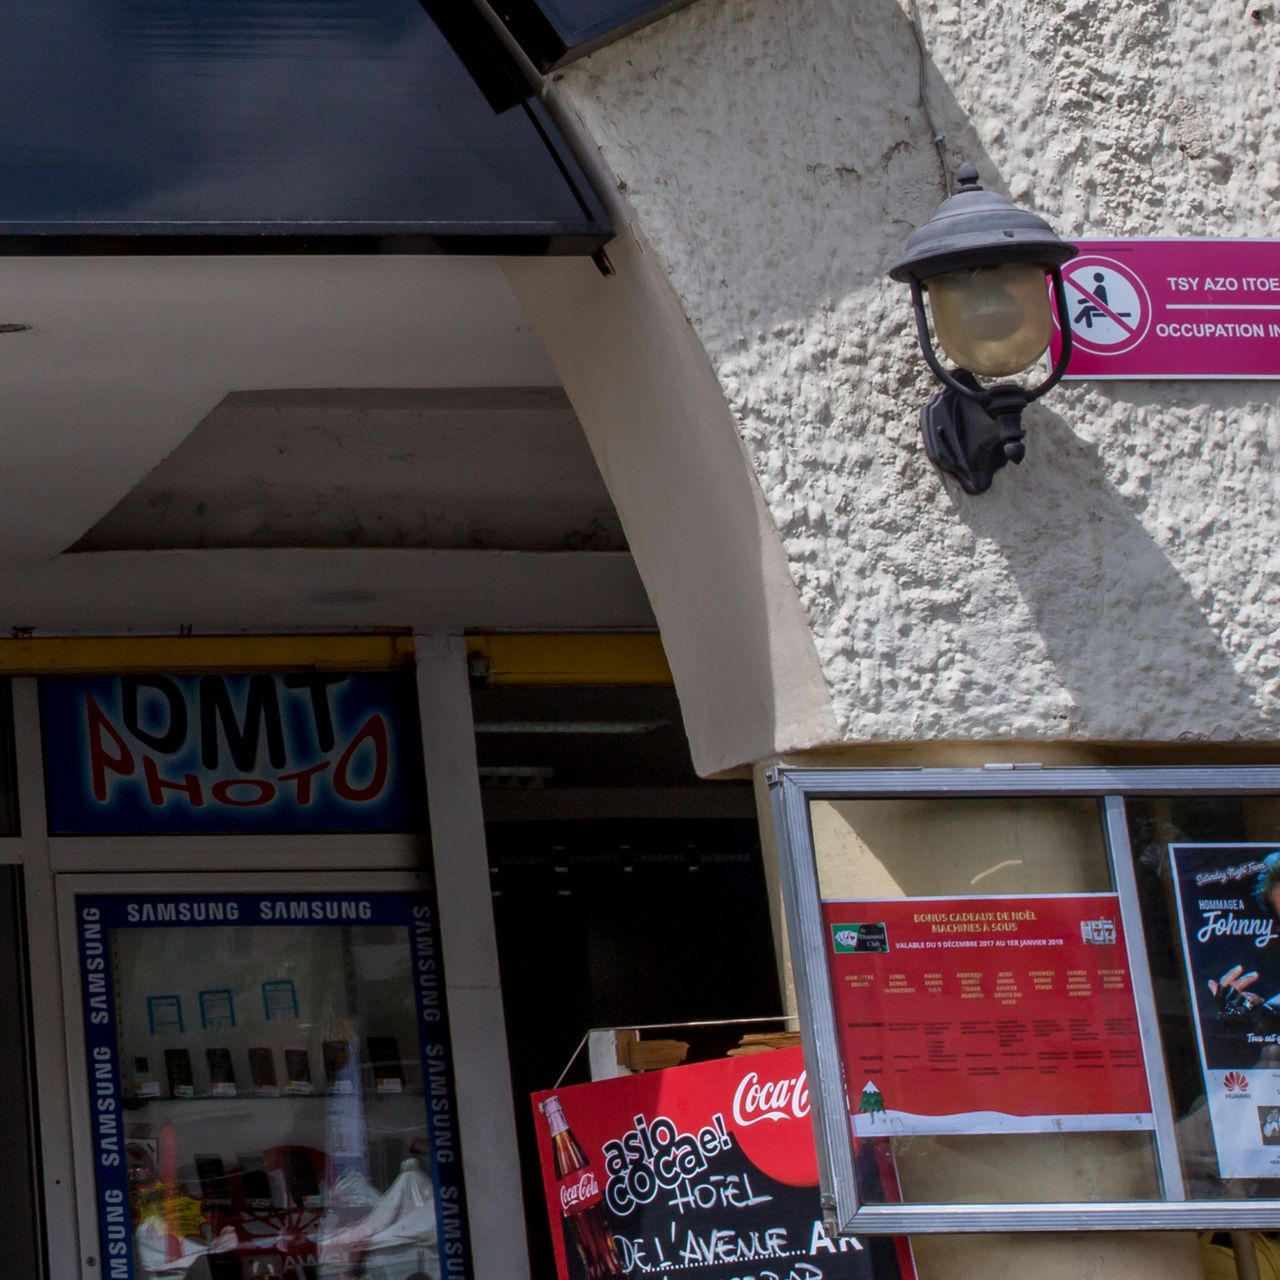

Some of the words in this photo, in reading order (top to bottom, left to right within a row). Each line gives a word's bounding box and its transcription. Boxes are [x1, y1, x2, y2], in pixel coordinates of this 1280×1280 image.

[1167, 277, 1200, 291] TSY
[1203, 277, 1238, 291] AZO
[1156, 323, 1265, 338] OCCUPATION
[86, 689, 388, 807] PHOTO
[127, 902, 239, 923] SAMSUNG
[258, 901, 372, 922] SAMSUNG
[913, 913, 948, 923] BONUS
[949, 912, 995, 922] CADEAUX
[997, 911, 1010, 921] DE
[931, 923, 981, 933] MACHINES
[991, 922, 1018, 932] SOUS
[1197, 911, 1278, 948] Johnny
[82, 907, 109, 1025] SAMSUNG
[413, 906, 441, 1023] SAMSUNG
[895, 941, 925, 949] VALABLE
[1048, 938, 1064, 947] 2018
[93, 1046, 120, 1168] SAMSUNG
[426, 1044, 455, 1164] SAMSUNG
[602, 1113, 678, 1176] asio
[104, 1189, 130, 1280] MSUNG
